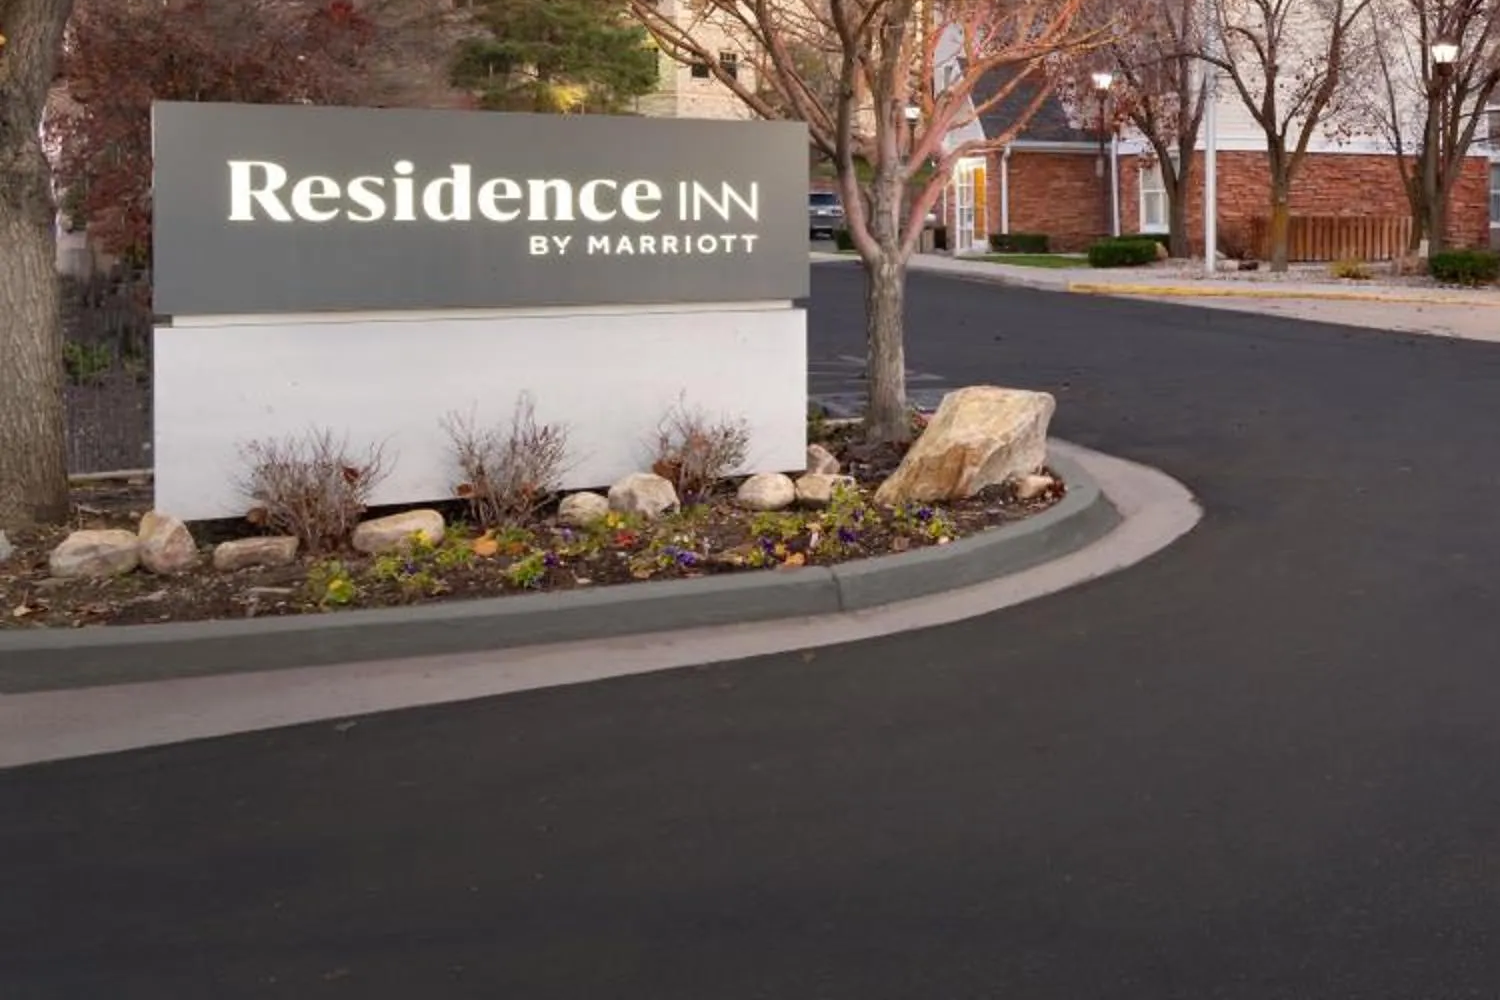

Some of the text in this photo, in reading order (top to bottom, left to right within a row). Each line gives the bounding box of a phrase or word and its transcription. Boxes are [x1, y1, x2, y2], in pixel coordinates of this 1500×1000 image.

[227, 160, 760, 223] Residence INN
[529, 233, 759, 255] BY MARRIOTT
